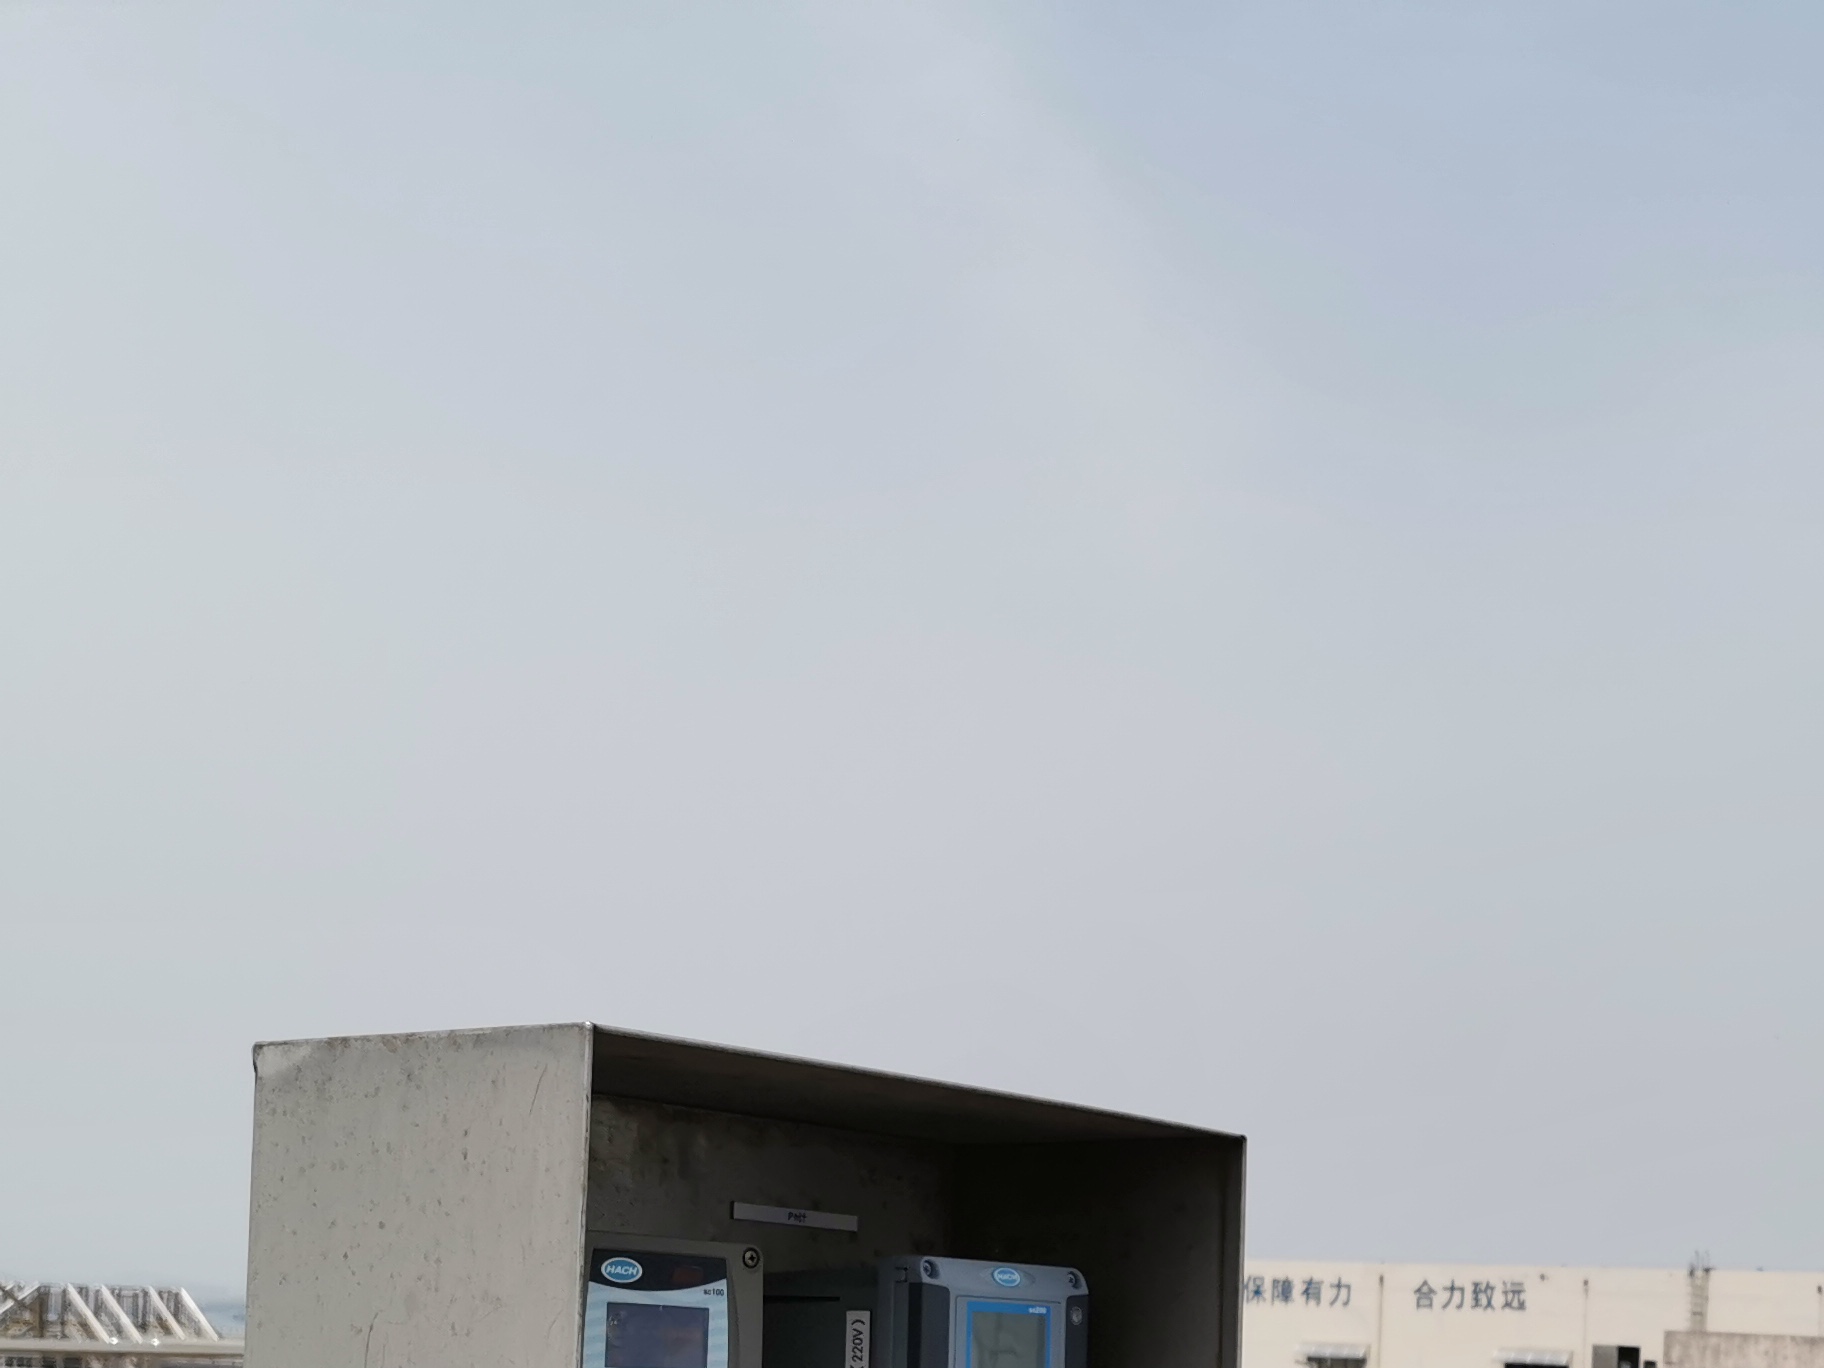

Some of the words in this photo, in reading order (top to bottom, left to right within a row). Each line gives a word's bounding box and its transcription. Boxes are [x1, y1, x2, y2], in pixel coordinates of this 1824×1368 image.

[605, 1264, 638, 1276] HACH
[1244, 1275, 1352, 1309] 保障有力
[1413, 1279, 1528, 1311] 合力致远
